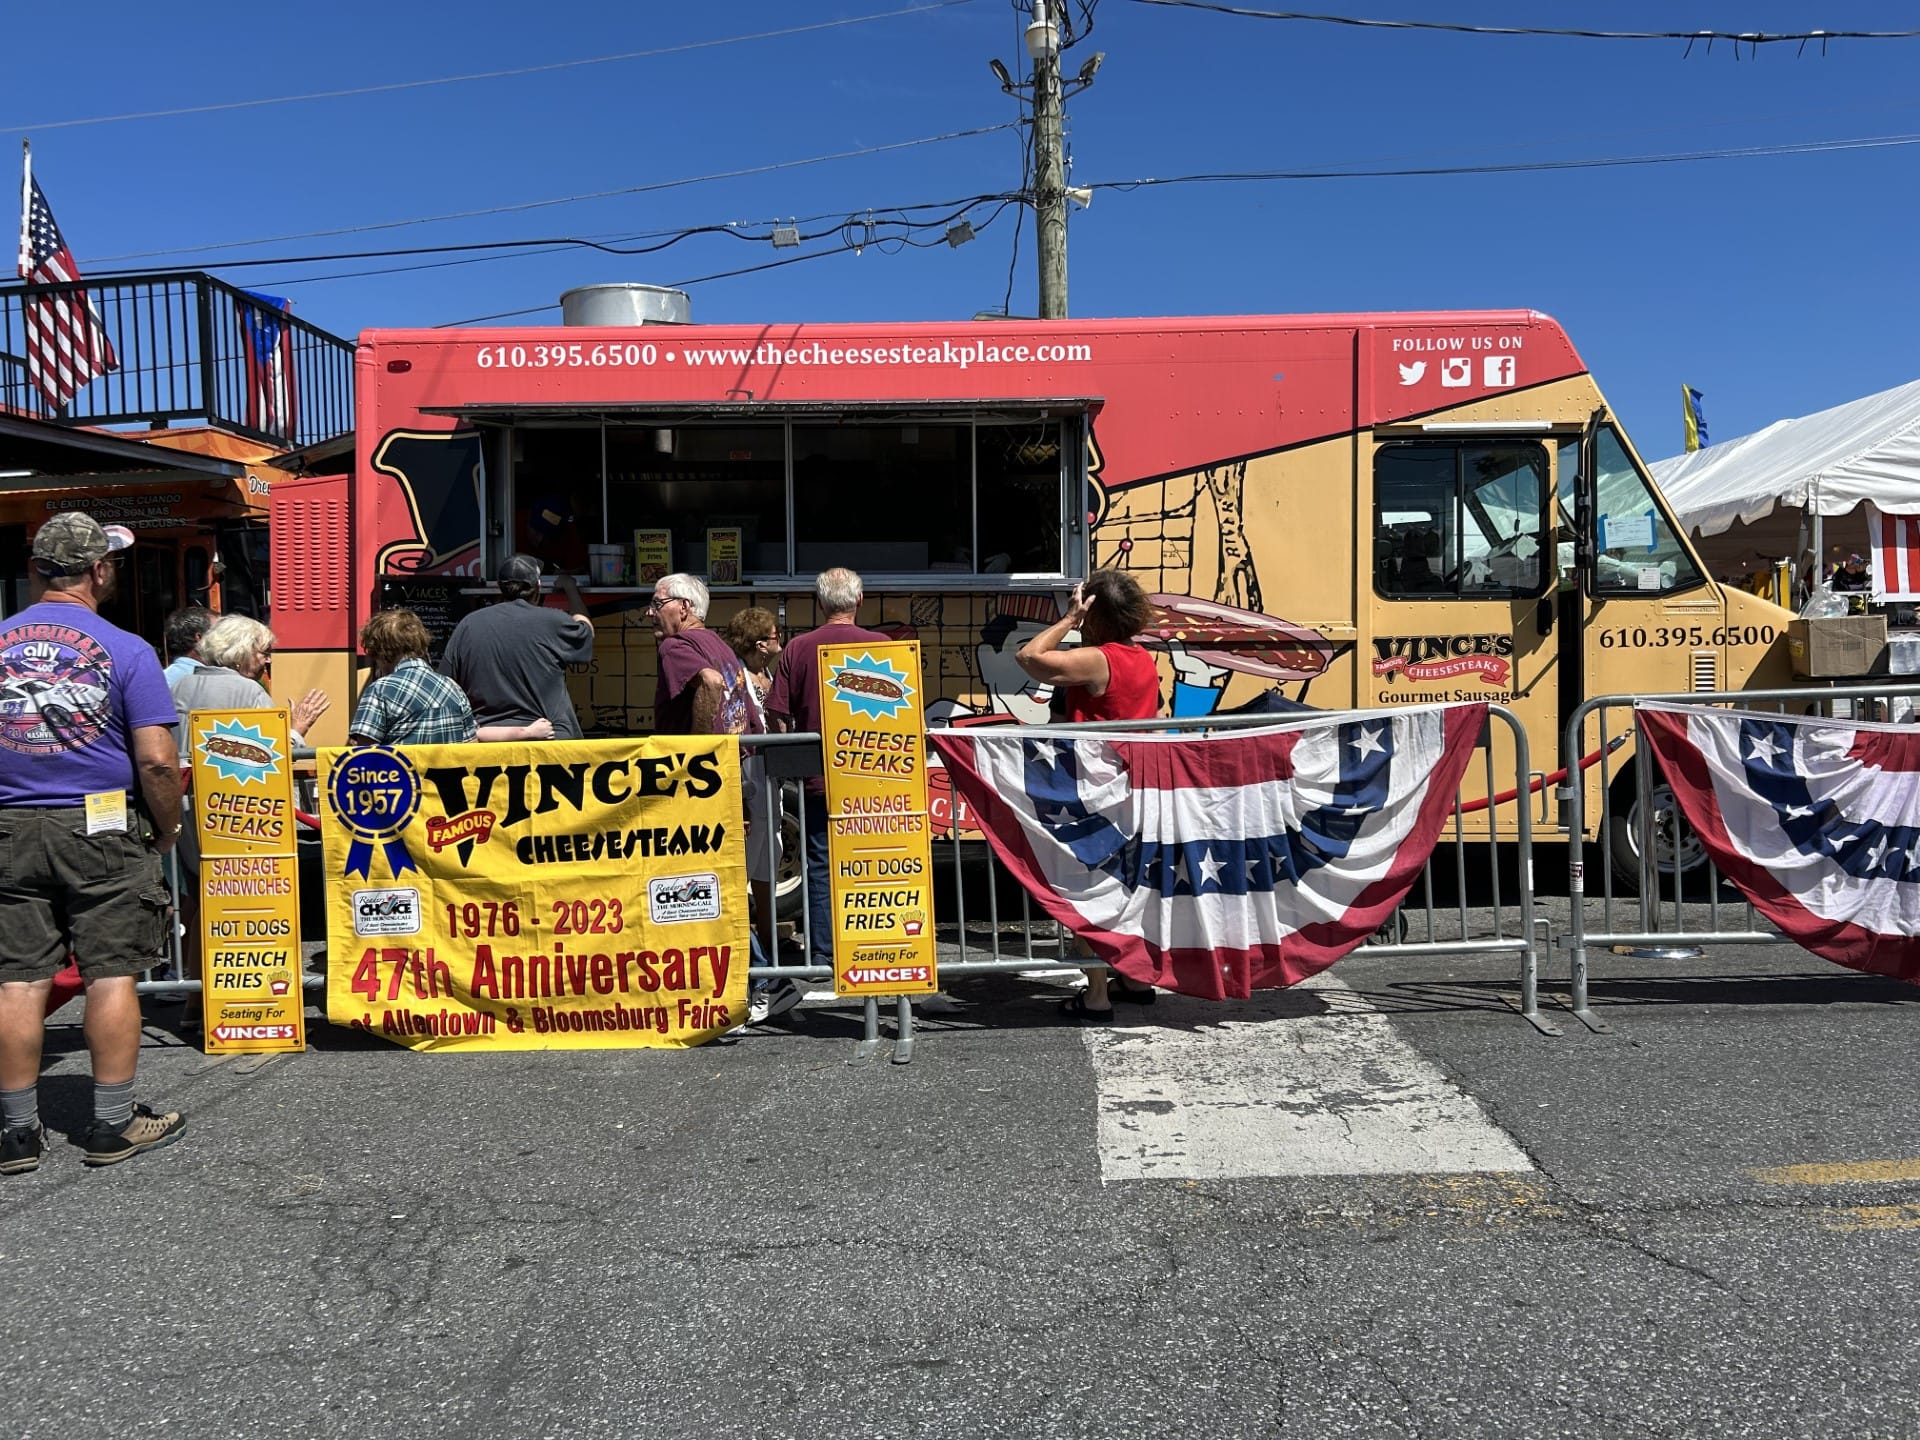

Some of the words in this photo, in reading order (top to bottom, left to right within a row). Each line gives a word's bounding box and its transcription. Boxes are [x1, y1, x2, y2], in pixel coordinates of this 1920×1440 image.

[1393, 337, 1465, 351] FOLLOW
[1471, 336, 1494, 350] US
[1499, 336, 1523, 349] ON
[477, 343, 658, 370] 610.395.6500
[684, 340, 1092, 370] www.thecheesesteakplace.com
[1599, 625, 1776, 649] 610.395.6500
[23, 642, 60, 661] ally
[1372, 634, 1513, 684] VINCE'S
[1409, 660, 1500, 678] CHEESESTEAKS
[1378, 690, 1450, 703] Gourmet
[1454, 689, 1519, 705] Sausage
[835, 728, 917, 753] CHEESE
[832, 750, 915, 775] STEAKS
[347, 766, 400, 784] Since
[206, 792, 286, 817] CHEESE
[345, 789, 402, 817] 1957
[424, 752, 723, 868] VINCE'S
[841, 793, 912, 815] SAUSAGE
[204, 814, 284, 838] STEAKS
[433, 813, 492, 844] FAMOUS
[835, 815, 923, 837] SANDWICHES
[516, 823, 726, 865] CHEESESTEAKS
[212, 857, 280, 877] SAUSAGE
[840, 860, 871, 878] HOT
[878, 857, 923, 876] DOGS
[206, 877, 292, 897] SANDWICHES
[656, 888, 713, 904] CHOICE
[359, 901, 412, 916] CHOICE
[843, 890, 920, 910] FRENCH
[210, 920, 243, 938] HOT
[246, 918, 291, 936] DOGS
[446, 902, 520, 938] 1976
[552, 898, 624, 936] 2023
[844, 912, 896, 932] FRIES
[212, 951, 287, 968] FRENCH
[852, 950, 896, 963] Seating
[897, 949, 918, 961] For
[213, 972, 263, 990] FRIES
[351, 945, 453, 1001] 47th
[471, 942, 732, 1000] Anniversary
[847, 966, 928, 983] VINCE'S
[220, 1009, 263, 1022] Seating
[264, 1008, 286, 1020] For
[382, 1008, 496, 1037] Allentown
[506, 1013, 525, 1034] &
[535, 1001, 670, 1035] Bloomsburg
[678, 997, 731, 1029] Fairs
[217, 1024, 294, 1041] VINCE'S
